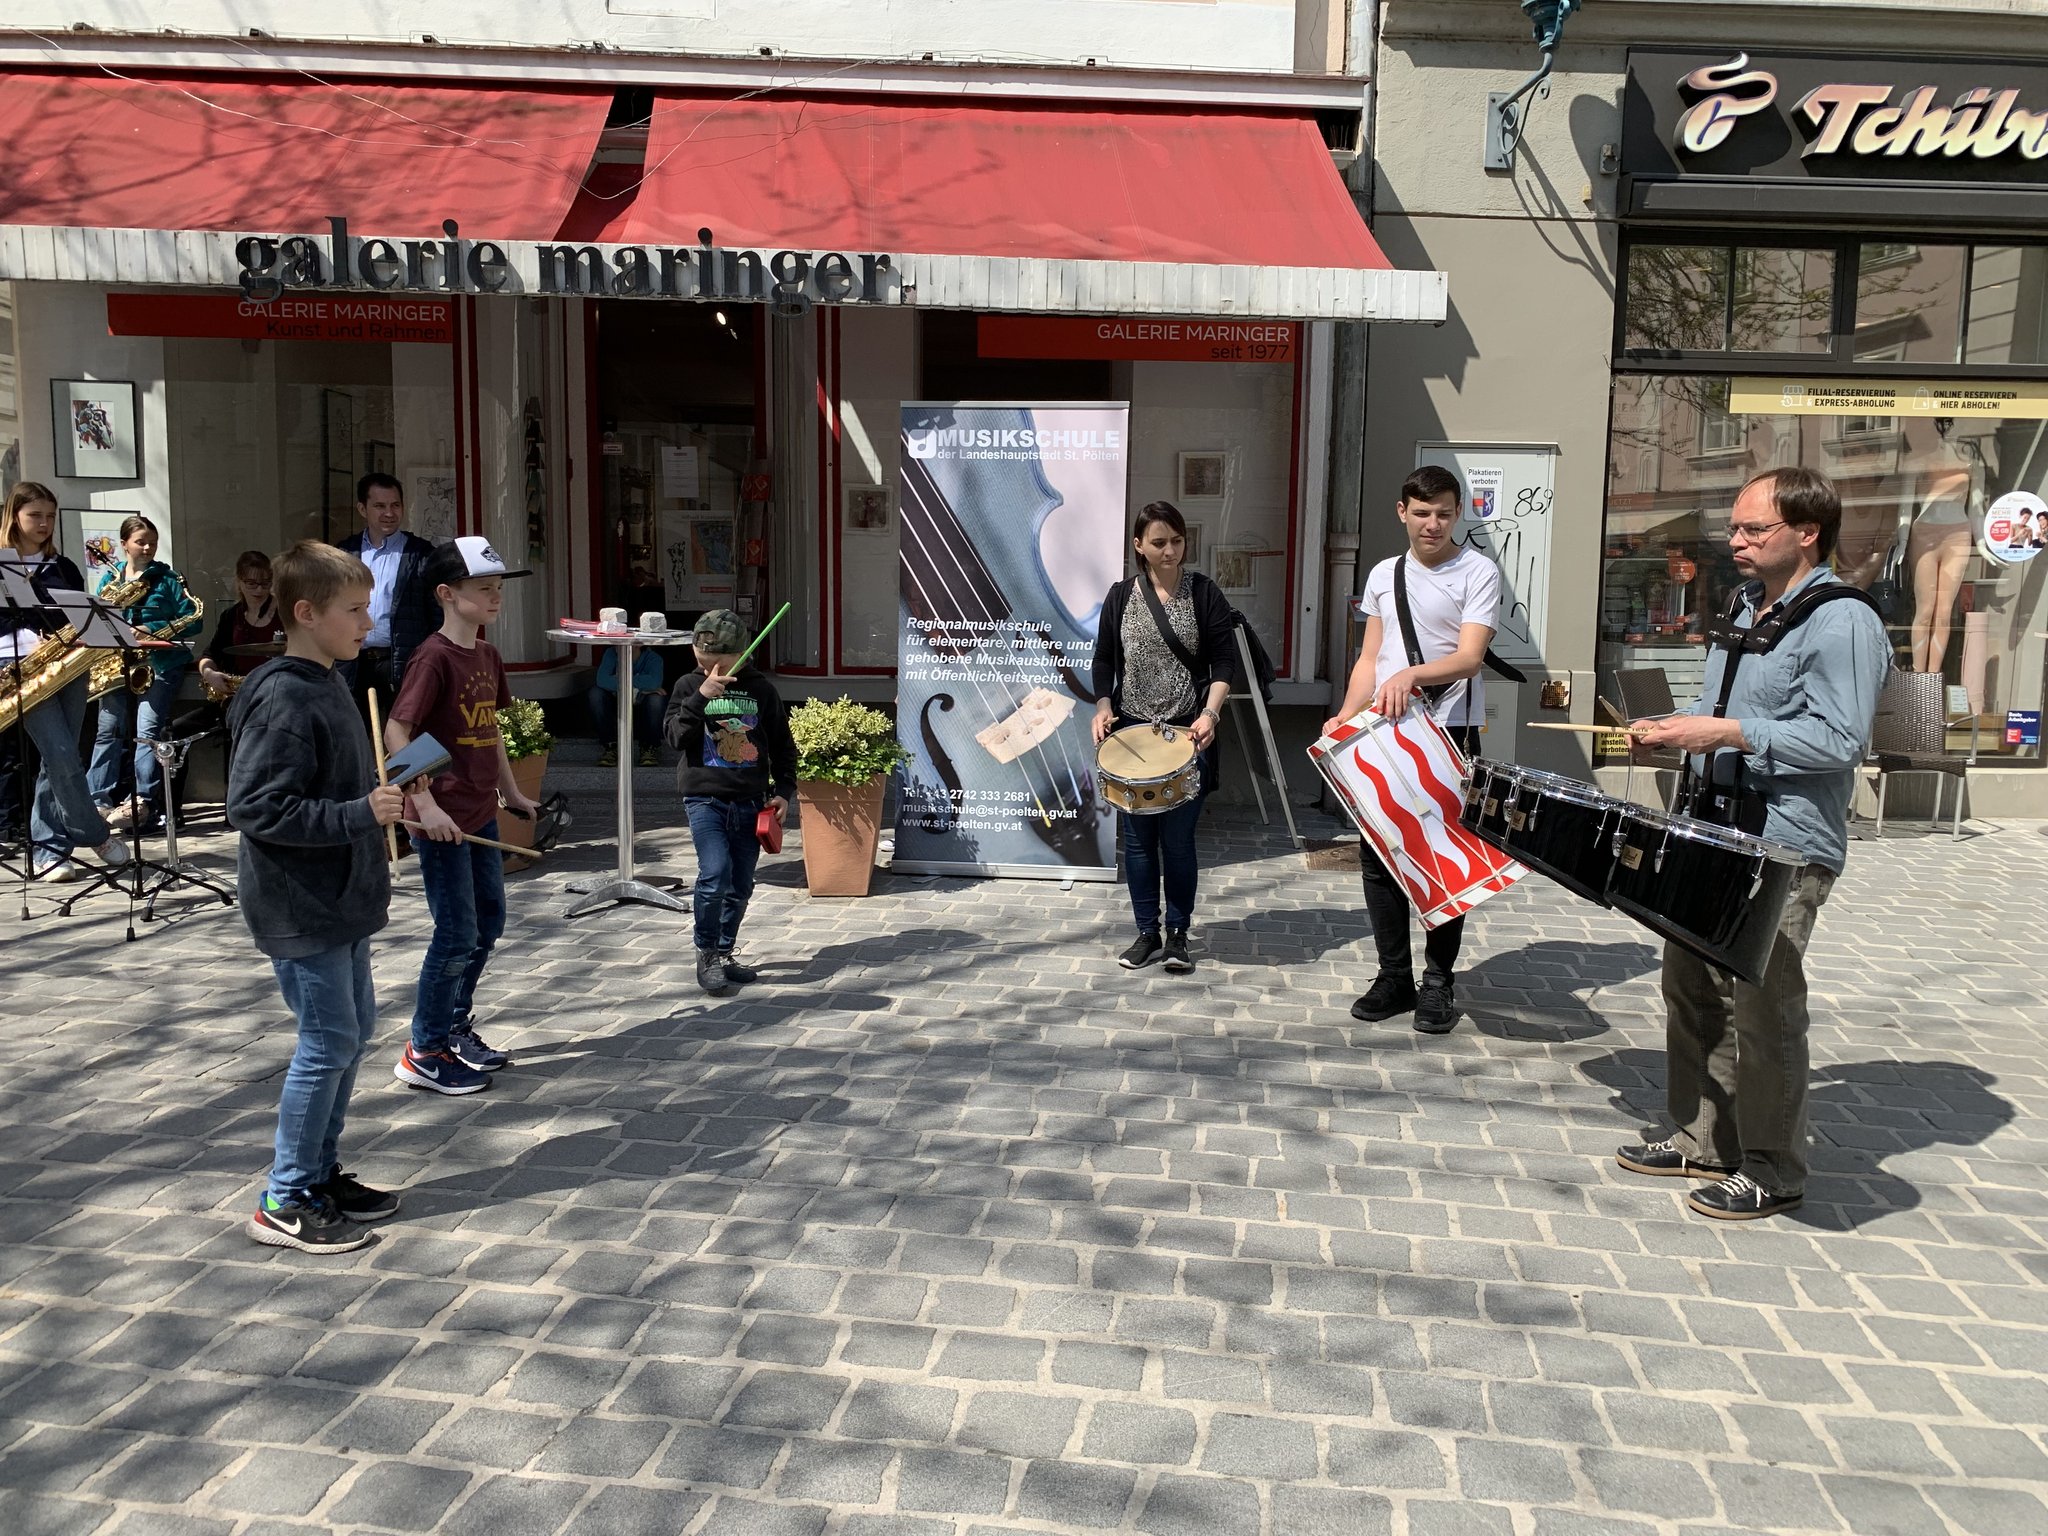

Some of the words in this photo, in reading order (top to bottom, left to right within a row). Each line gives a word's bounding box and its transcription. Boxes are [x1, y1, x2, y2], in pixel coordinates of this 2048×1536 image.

[235, 216, 508, 305] galerie
[534, 227, 892, 319] maringer
[237, 301, 328, 319] GALERIE
[342, 302, 446, 322] MARINGER
[267, 321, 324, 338] Kunst
[328, 321, 364, 339] und
[369, 323, 446, 341] Rahmen
[1097, 323, 1181, 341] GALERIE
[1186, 325, 1289, 343] MARINGER
[1211, 344, 1242, 359] seit
[1248, 344, 1289, 360] 1977
[1807, 387, 1896, 398] FILIAL-RESERVIERUNG
[1933, 390, 1963, 399] ONLINE
[1964, 390, 2018, 400] RESERVIEREN
[1814, 398, 1896, 408] EXPRESS-ABHOLUNG
[1940, 400, 1959, 409] HIER
[1961, 400, 2000, 410] ABHOLEN!
[937, 429, 1120, 448] MUSIKSCHULE
[937, 449, 956, 459] der
[959, 449, 1061, 462] Landeshauptstadt
[1063, 450, 1080, 461] St.
[1082, 450, 1119, 461] Pölten
[1468, 468, 1502, 476] Plakatieren
[906, 617, 1052, 632] Regionalmusikschule
[906, 634, 927, 647] für
[929, 636, 1007, 650] elementare,
[1011, 637, 1063, 650] mittlere
[1067, 639, 1094, 651] und
[905, 652, 973, 667] gehobene
[975, 654, 1094, 670] Musikausbildung
[905, 669, 928, 681] mit
[930, 668, 1067, 684] Öffentlichkeitsrecht.
[459, 700, 497, 729] VAN
[903, 787, 923, 799] Tel.
[949, 789, 977, 800] 2742
[980, 790, 1000, 801] 333
[1003, 791, 1031, 802] 2681
[903, 802, 1078, 820] musikschule@st-poelten.gv.at
[902, 817, 1023, 832] www.st-poelten.gv.at
